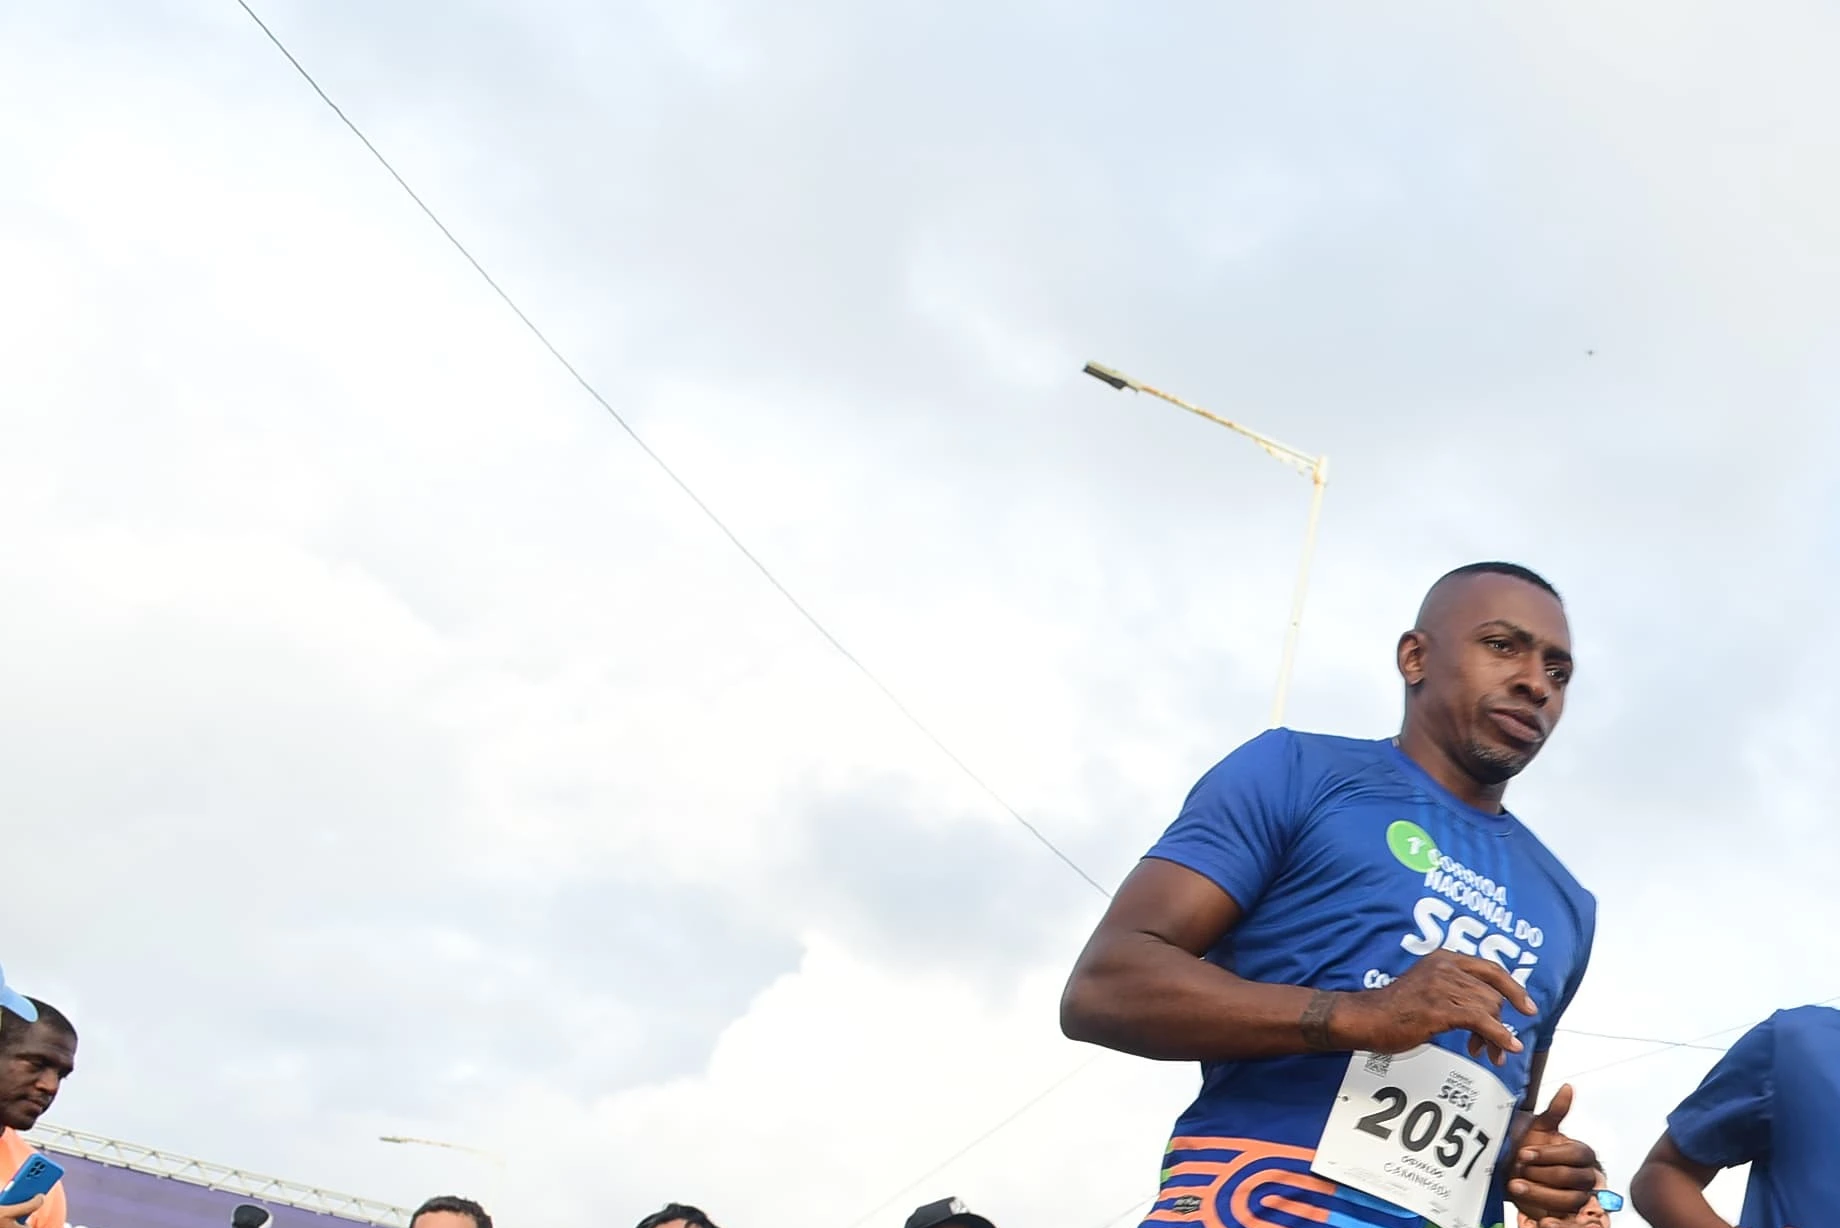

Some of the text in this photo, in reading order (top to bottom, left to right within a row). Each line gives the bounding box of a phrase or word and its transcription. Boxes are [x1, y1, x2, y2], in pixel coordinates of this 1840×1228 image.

[1424, 869, 1544, 948] NACIONAL DO
[1427, 848, 1508, 905] CORRIDA
[1355, 1086, 1490, 1180] 2057
